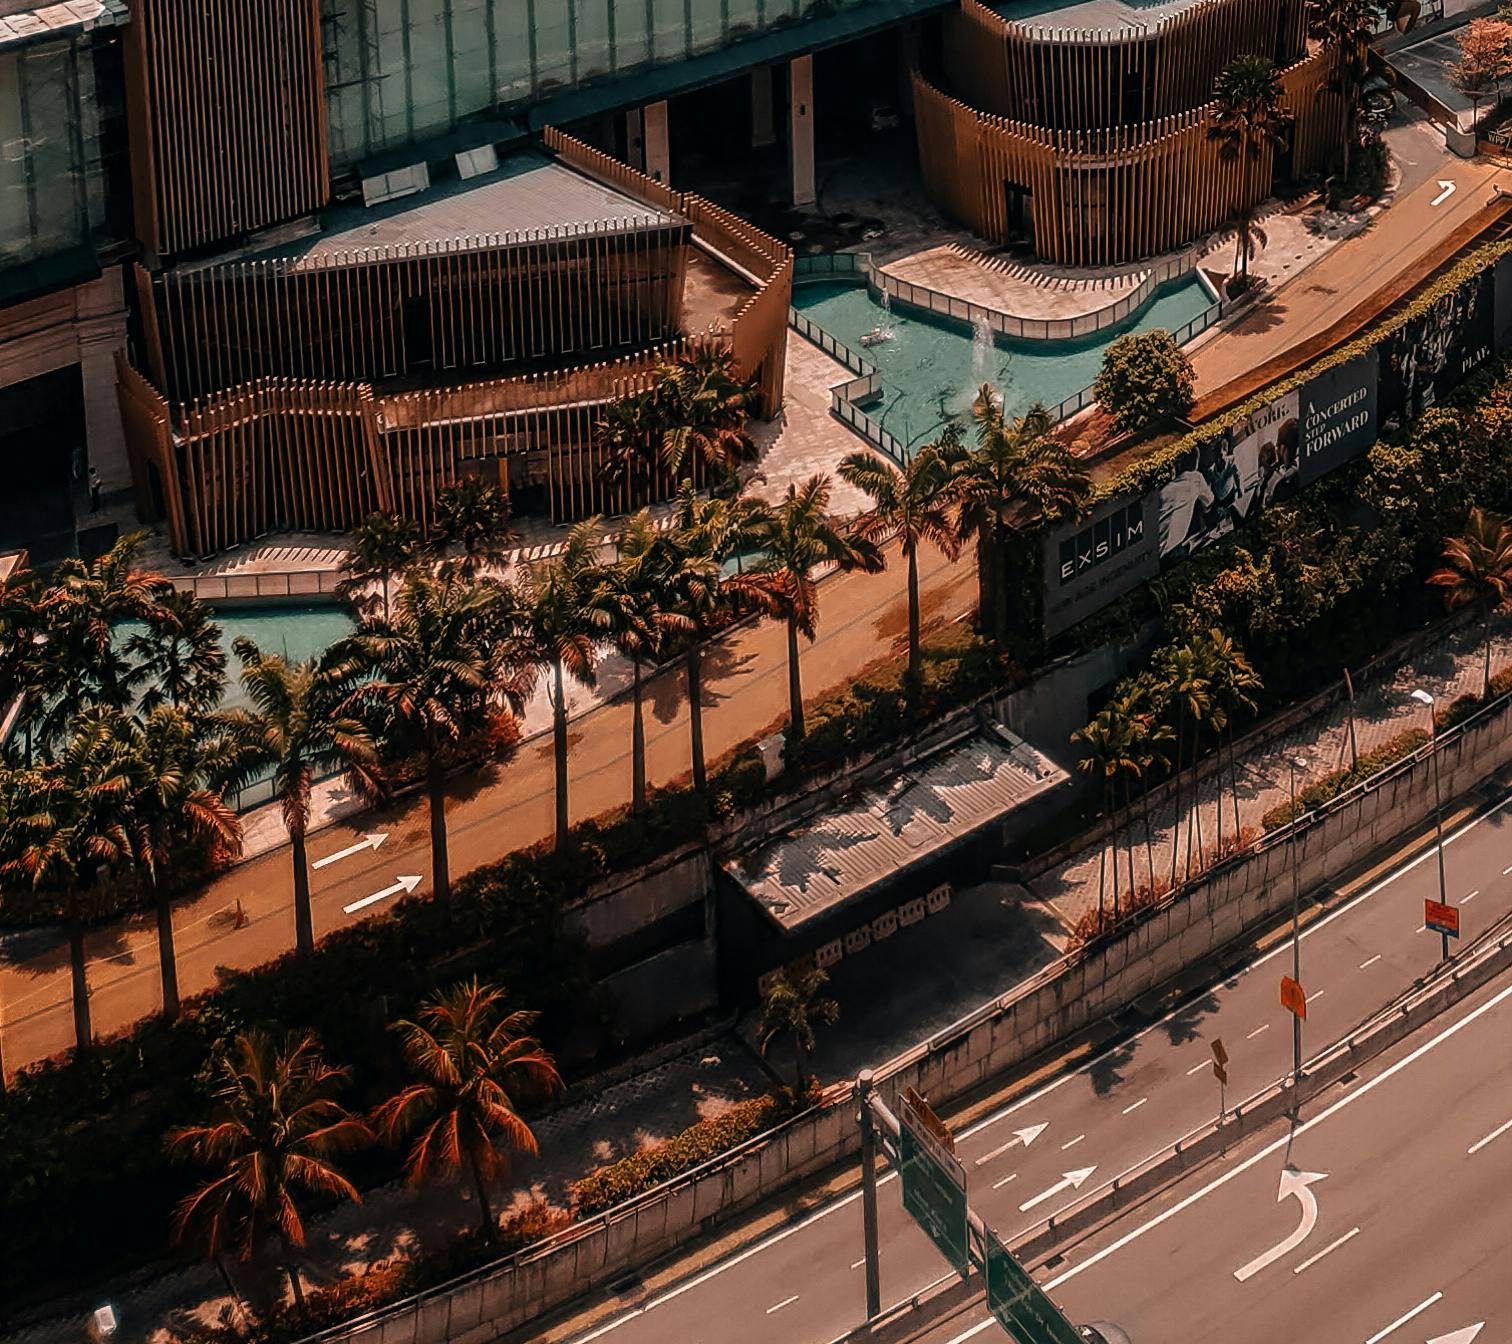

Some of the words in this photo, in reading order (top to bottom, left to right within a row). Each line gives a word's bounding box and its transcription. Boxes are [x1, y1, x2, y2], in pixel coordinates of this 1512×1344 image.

[1305, 386, 1368, 430] CONCERTED
[1307, 401, 1316, 414] A
[1305, 423, 1327, 442] STEP
[1305, 410, 1370, 457] FORWARD
[1060, 520, 1144, 579] EXSIM
